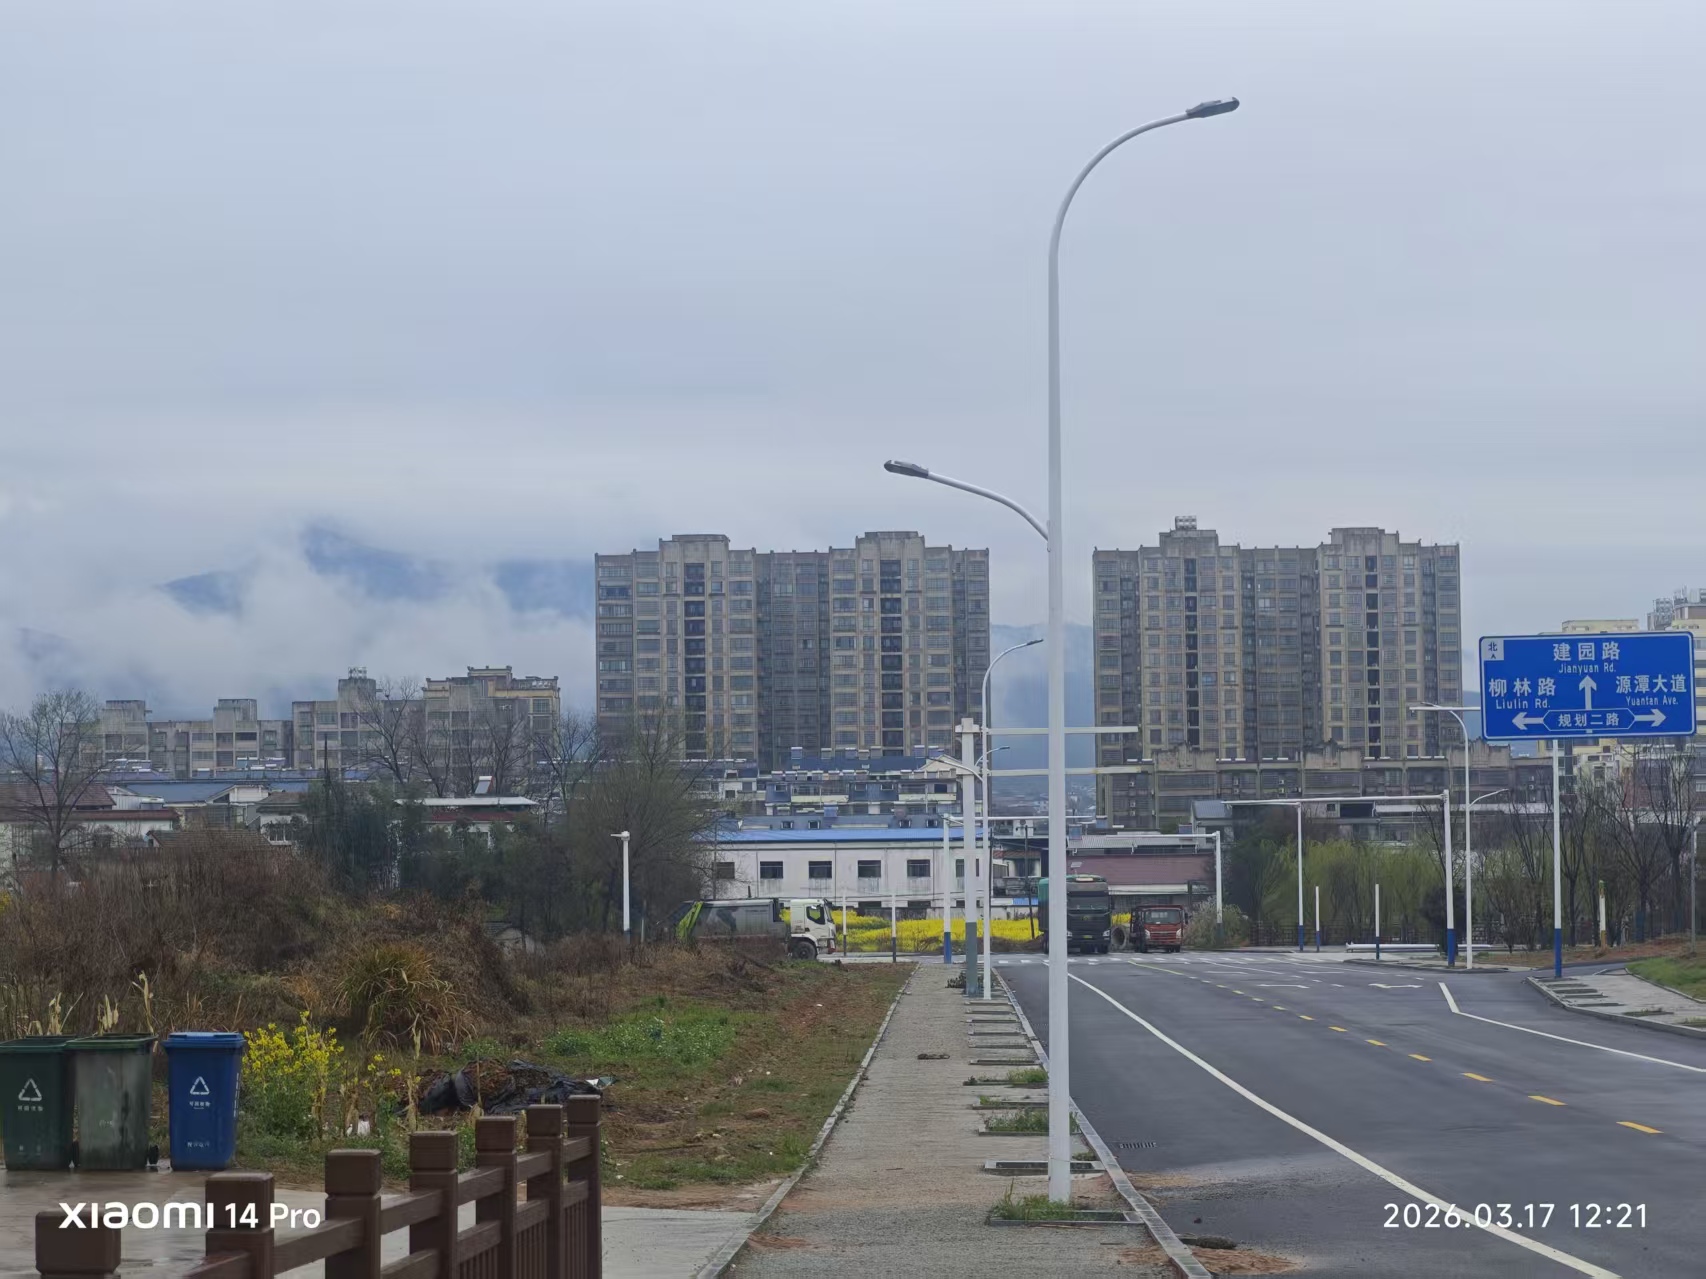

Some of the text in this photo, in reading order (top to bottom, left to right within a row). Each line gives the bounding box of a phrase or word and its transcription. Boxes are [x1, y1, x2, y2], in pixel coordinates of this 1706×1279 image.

[1487, 641, 1498, 651] 北
[1552, 641, 1621, 661] 建园路
[1558, 662, 1617, 676] Jianyuan Rd.
[1488, 677, 1557, 697] 柳林路
[1615, 673, 1687, 694] 源潭大道
[1495, 698, 1551, 710] Liulin Rd.
[1625, 695, 1679, 706] Yuantan Ave.
[1557, 712, 1620, 728] 规划二路
